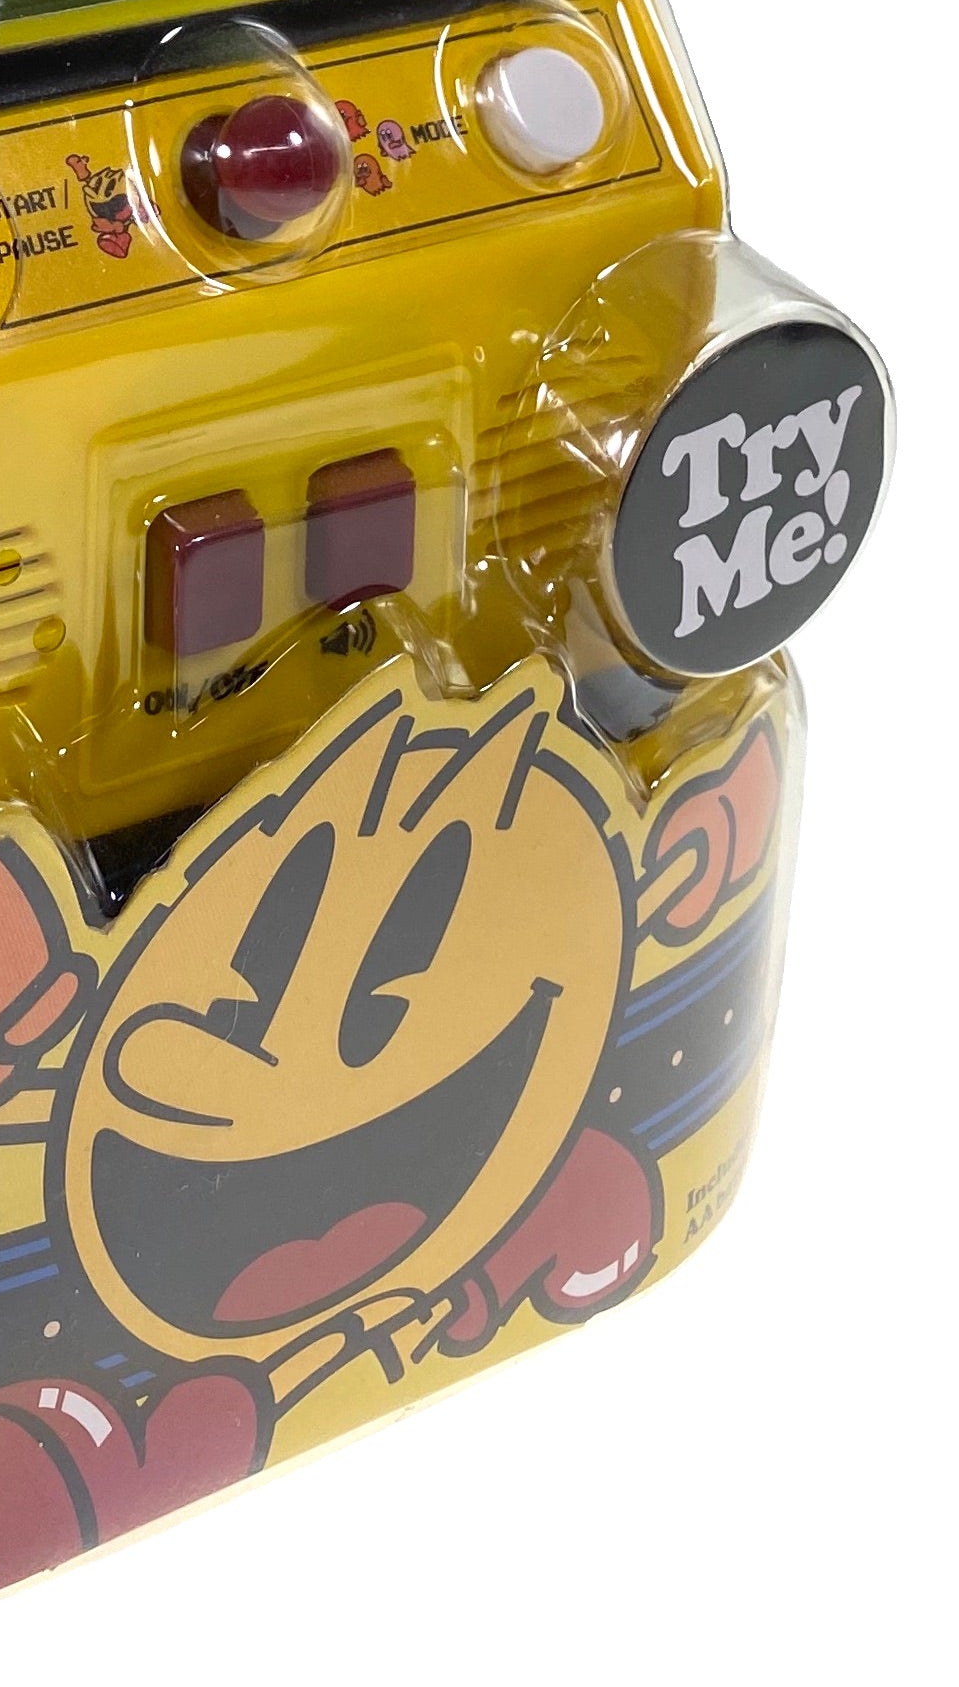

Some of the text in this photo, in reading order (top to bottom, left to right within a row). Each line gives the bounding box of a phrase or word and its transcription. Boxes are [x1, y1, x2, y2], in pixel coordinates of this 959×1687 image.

[410, 114, 469, 145] MODE
[662, 383, 863, 529] Try
[673, 469, 852, 639] Me!
